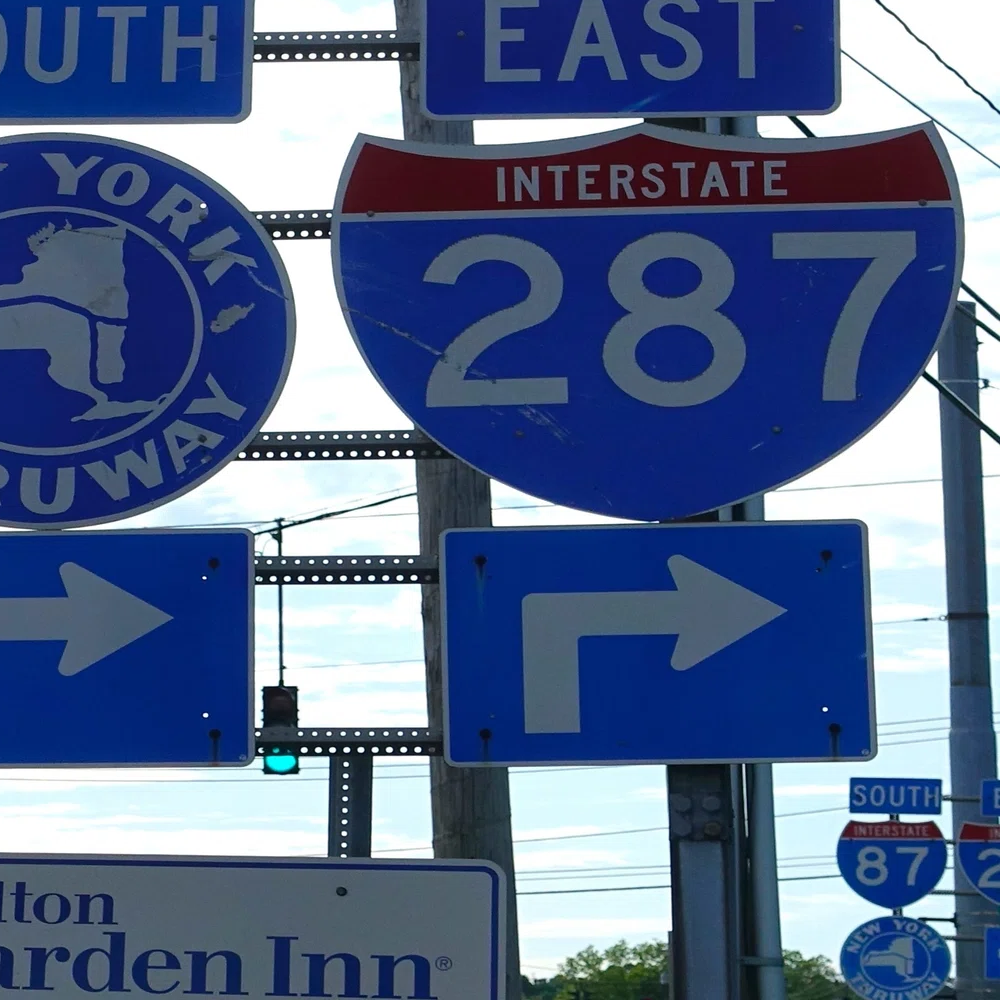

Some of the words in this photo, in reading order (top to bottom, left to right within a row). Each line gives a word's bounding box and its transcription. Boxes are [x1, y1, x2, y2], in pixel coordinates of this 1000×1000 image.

[496, 160, 788, 203] INTERSTATE
[40, 152, 262, 286] YORK
[422, 230, 917, 408] 287
[852, 785, 940, 808] SOUTH
[854, 825, 930, 838] INTERSTATE
[856, 846, 929, 886] 87
[846, 921, 881, 953] NEW
[892, 919, 943, 952] YORK
